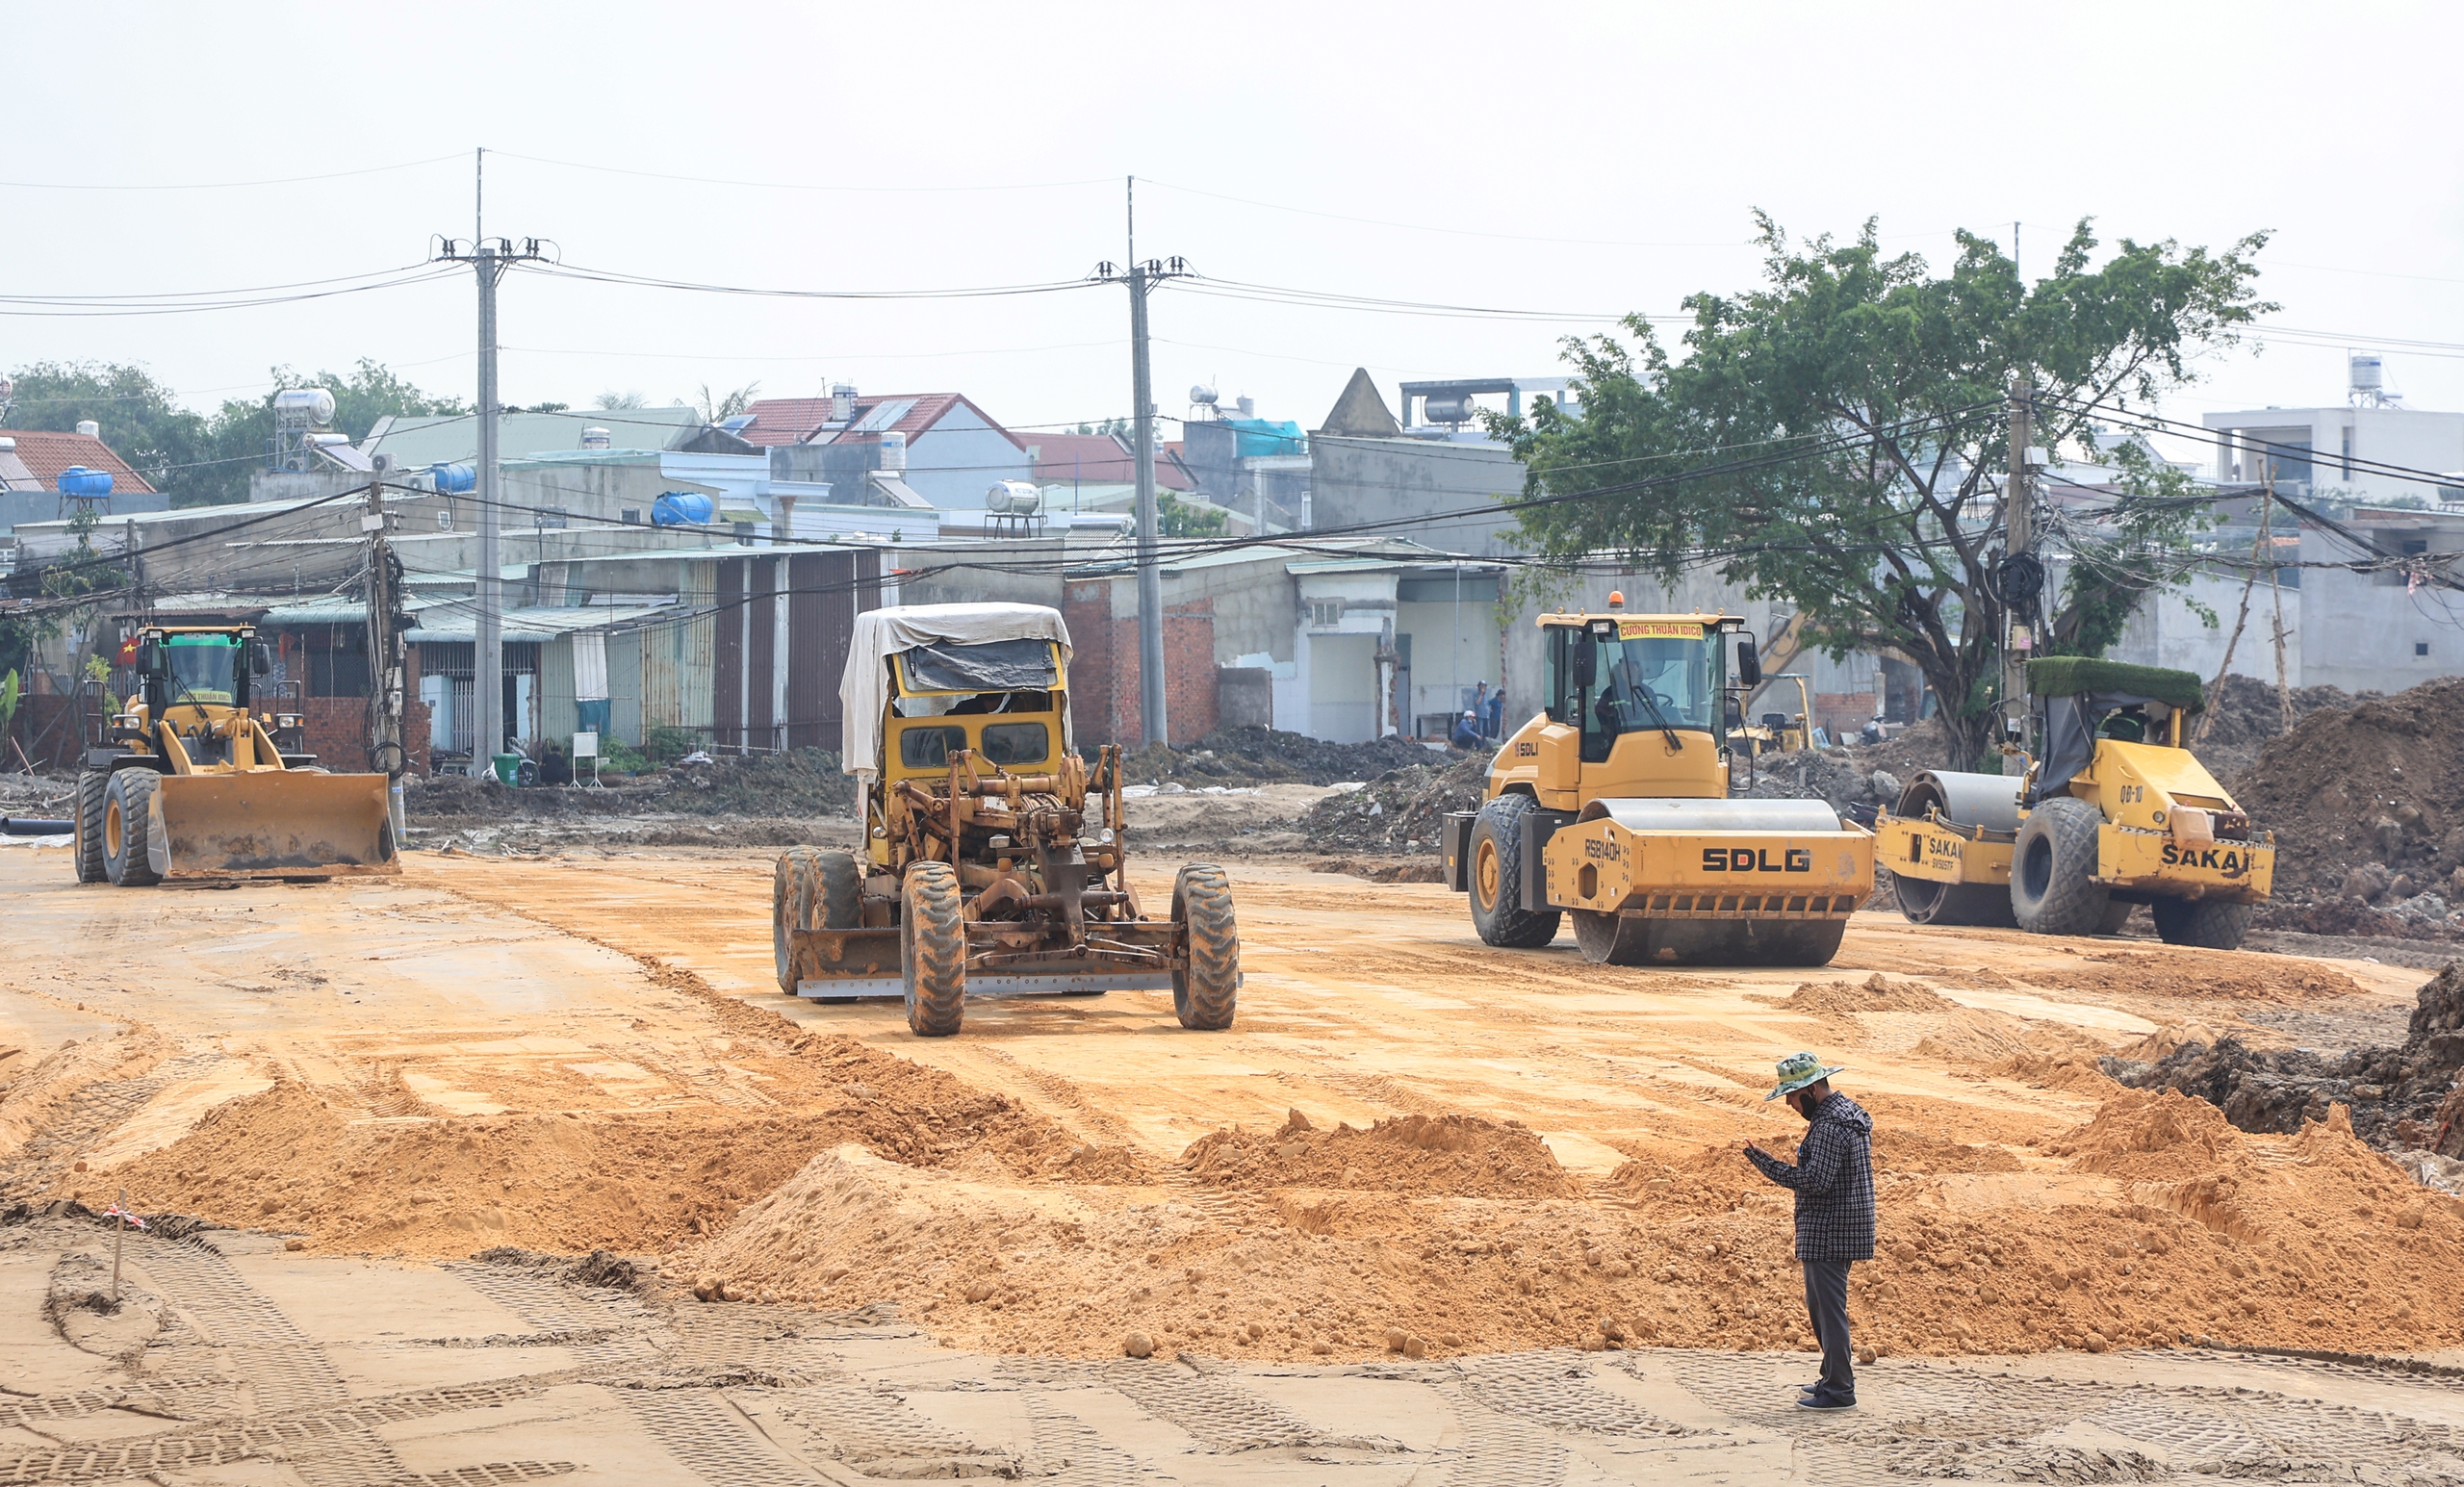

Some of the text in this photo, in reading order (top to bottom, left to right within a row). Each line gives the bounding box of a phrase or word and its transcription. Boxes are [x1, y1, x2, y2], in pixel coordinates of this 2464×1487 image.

[1681, 626, 1702, 637] IDICO
[1520, 742, 1538, 756] SDL
[1702, 848, 1810, 872] SDLG
